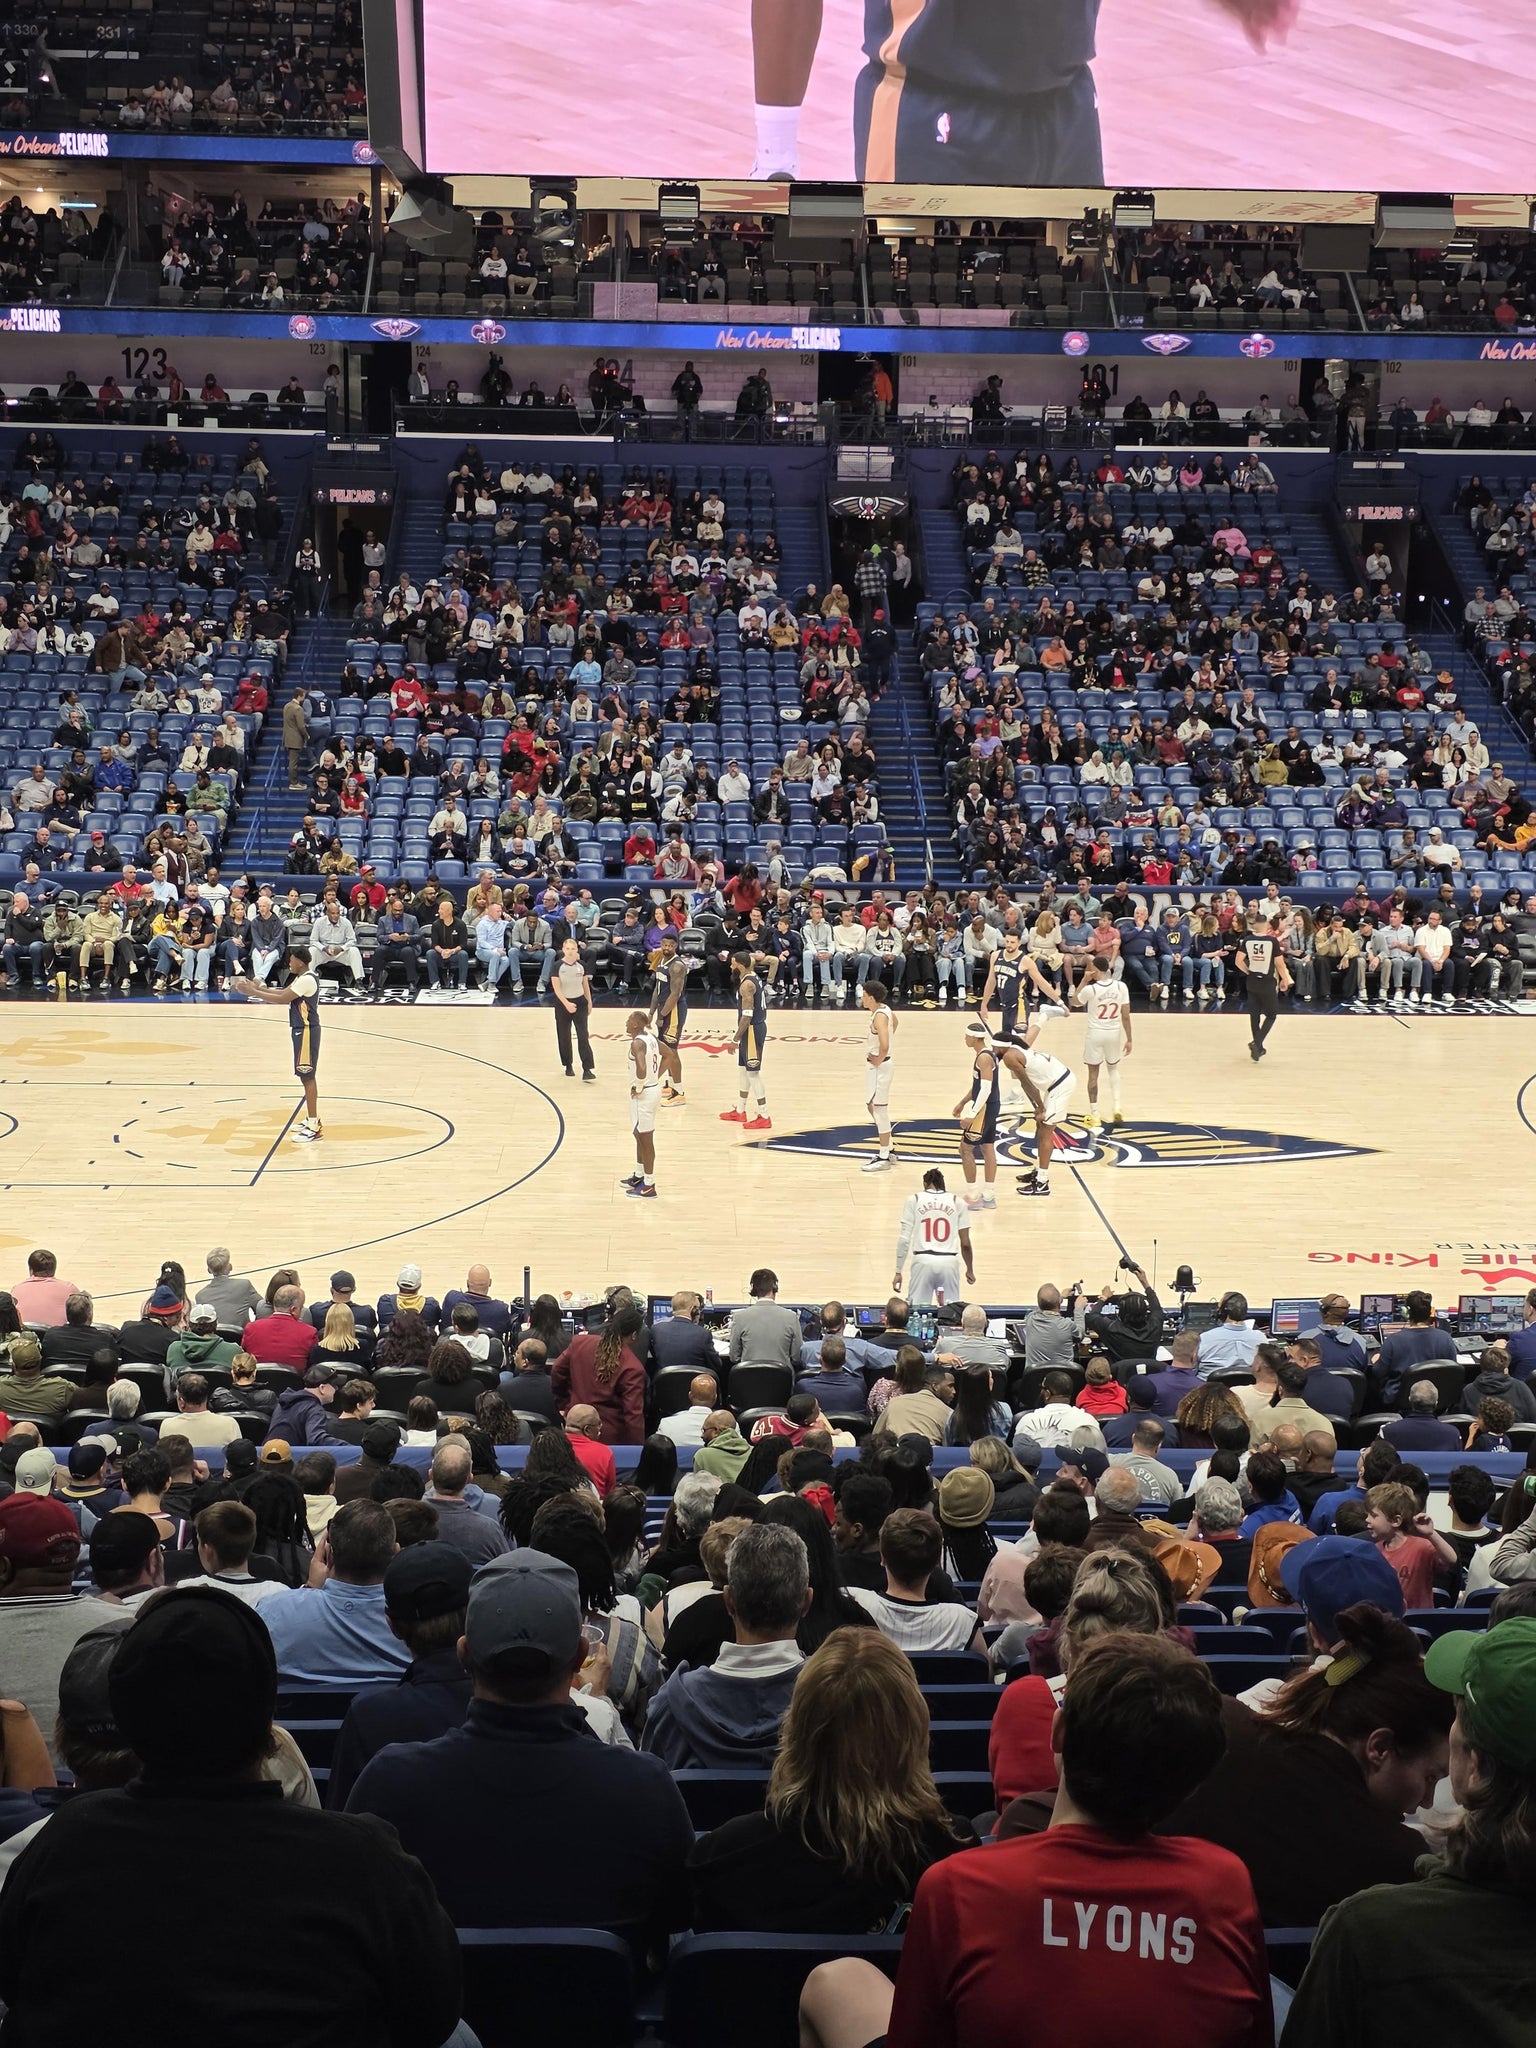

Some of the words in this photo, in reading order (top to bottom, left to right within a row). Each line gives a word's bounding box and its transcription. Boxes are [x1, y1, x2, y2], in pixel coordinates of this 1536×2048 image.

[96, 26, 121, 39] 331
[14, 135, 61, 154] Orleans
[59, 132, 109, 157] PELICANS
[703, 263, 719, 272] NY
[10, 308, 61, 333] PELICANS
[715, 328, 744, 348] New
[745, 330, 794, 349] Orleans
[791, 327, 841, 350] PELICANS
[309, 343, 326, 355] 123
[415, 345, 431, 358] 124
[1479, 339, 1510, 361] New
[121, 347, 168, 380] 123
[799, 354, 815, 366] 124
[902, 356, 917, 367] 101
[1283, 360, 1298, 372] 101
[1386, 361, 1402, 373] 102
[329, 488, 376, 504] PELICANS
[1357, 505, 1404, 520] PELICANS
[1253, 943, 1265, 955] 54
[997, 974, 1009, 989] 17
[1097, 1002, 1120, 1020] 22
[917, 1201, 955, 1217] GARLAND
[920, 1216, 951, 1243] 10
[1041, 1898, 1197, 1965] LYONS
